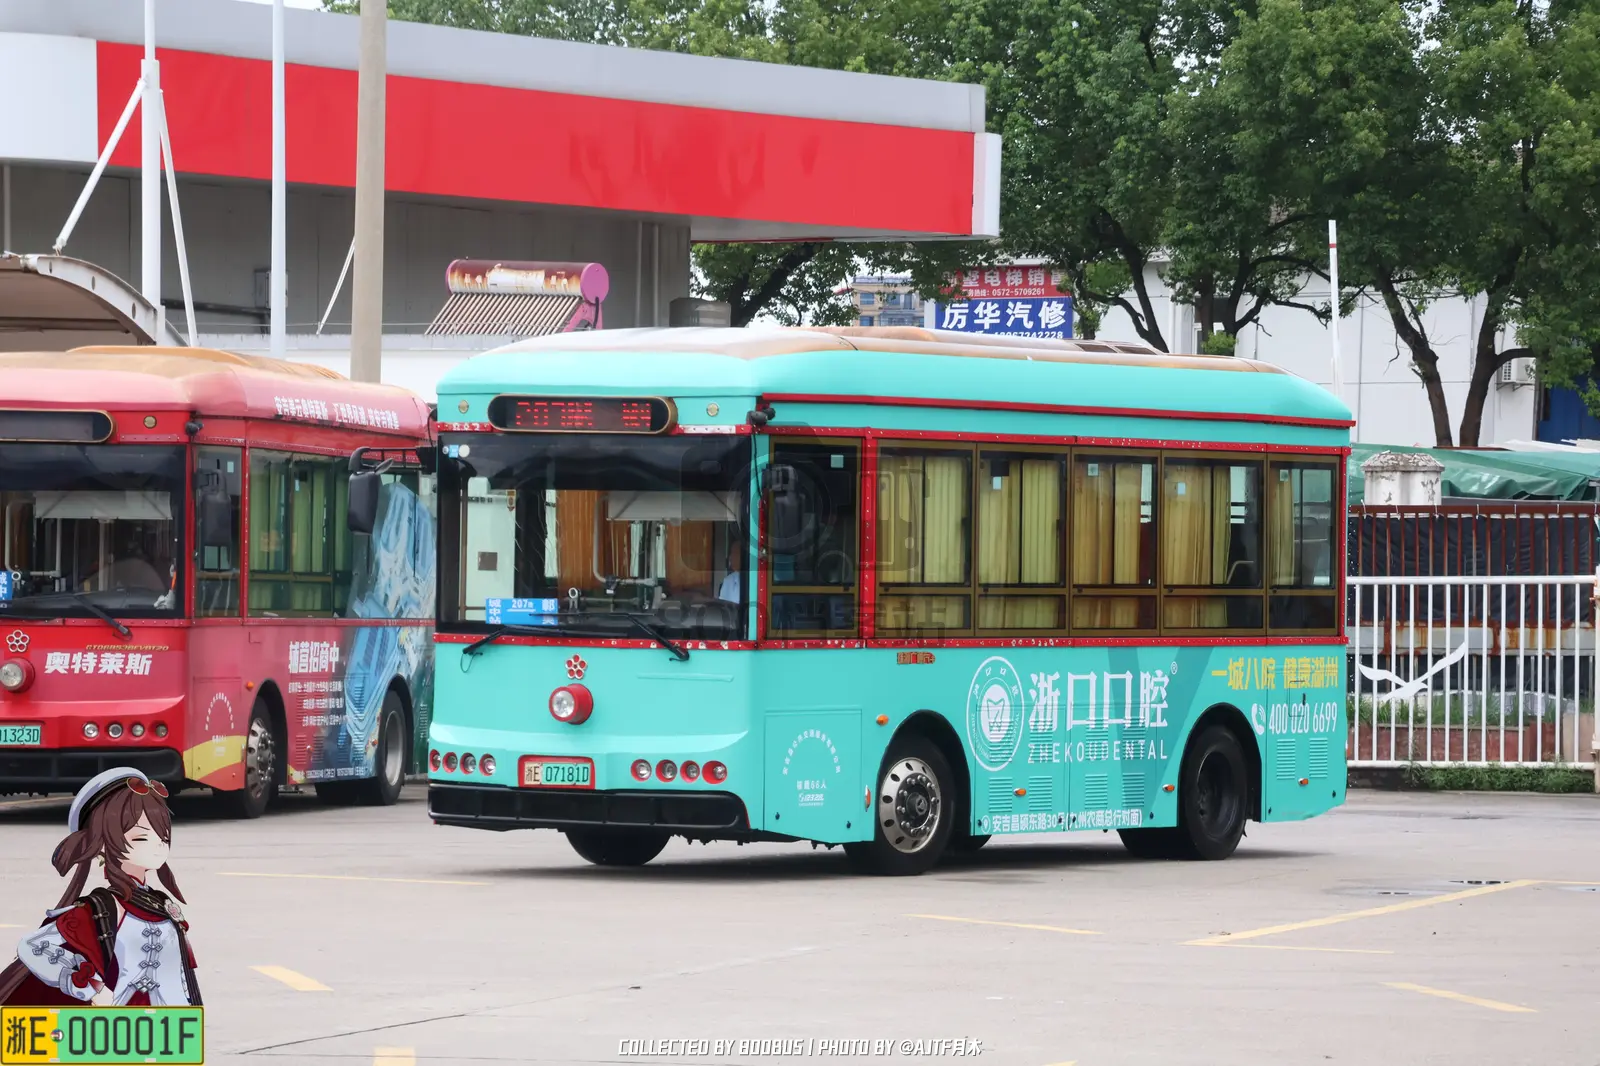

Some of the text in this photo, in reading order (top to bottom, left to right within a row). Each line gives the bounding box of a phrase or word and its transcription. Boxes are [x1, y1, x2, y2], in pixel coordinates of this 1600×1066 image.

[942, 301, 1067, 330] 厉华汽修
[44, 651, 153, 675] 奥特莱斯
[1211, 656, 1339, 690] 一城八院 健康湖州
[1028, 669, 1170, 732] 浙口口腔
[1269, 702, 1338, 735] 400 020 6699
[0, 728, 40, 743] 1323D
[545, 766, 589, 783] 07181D
